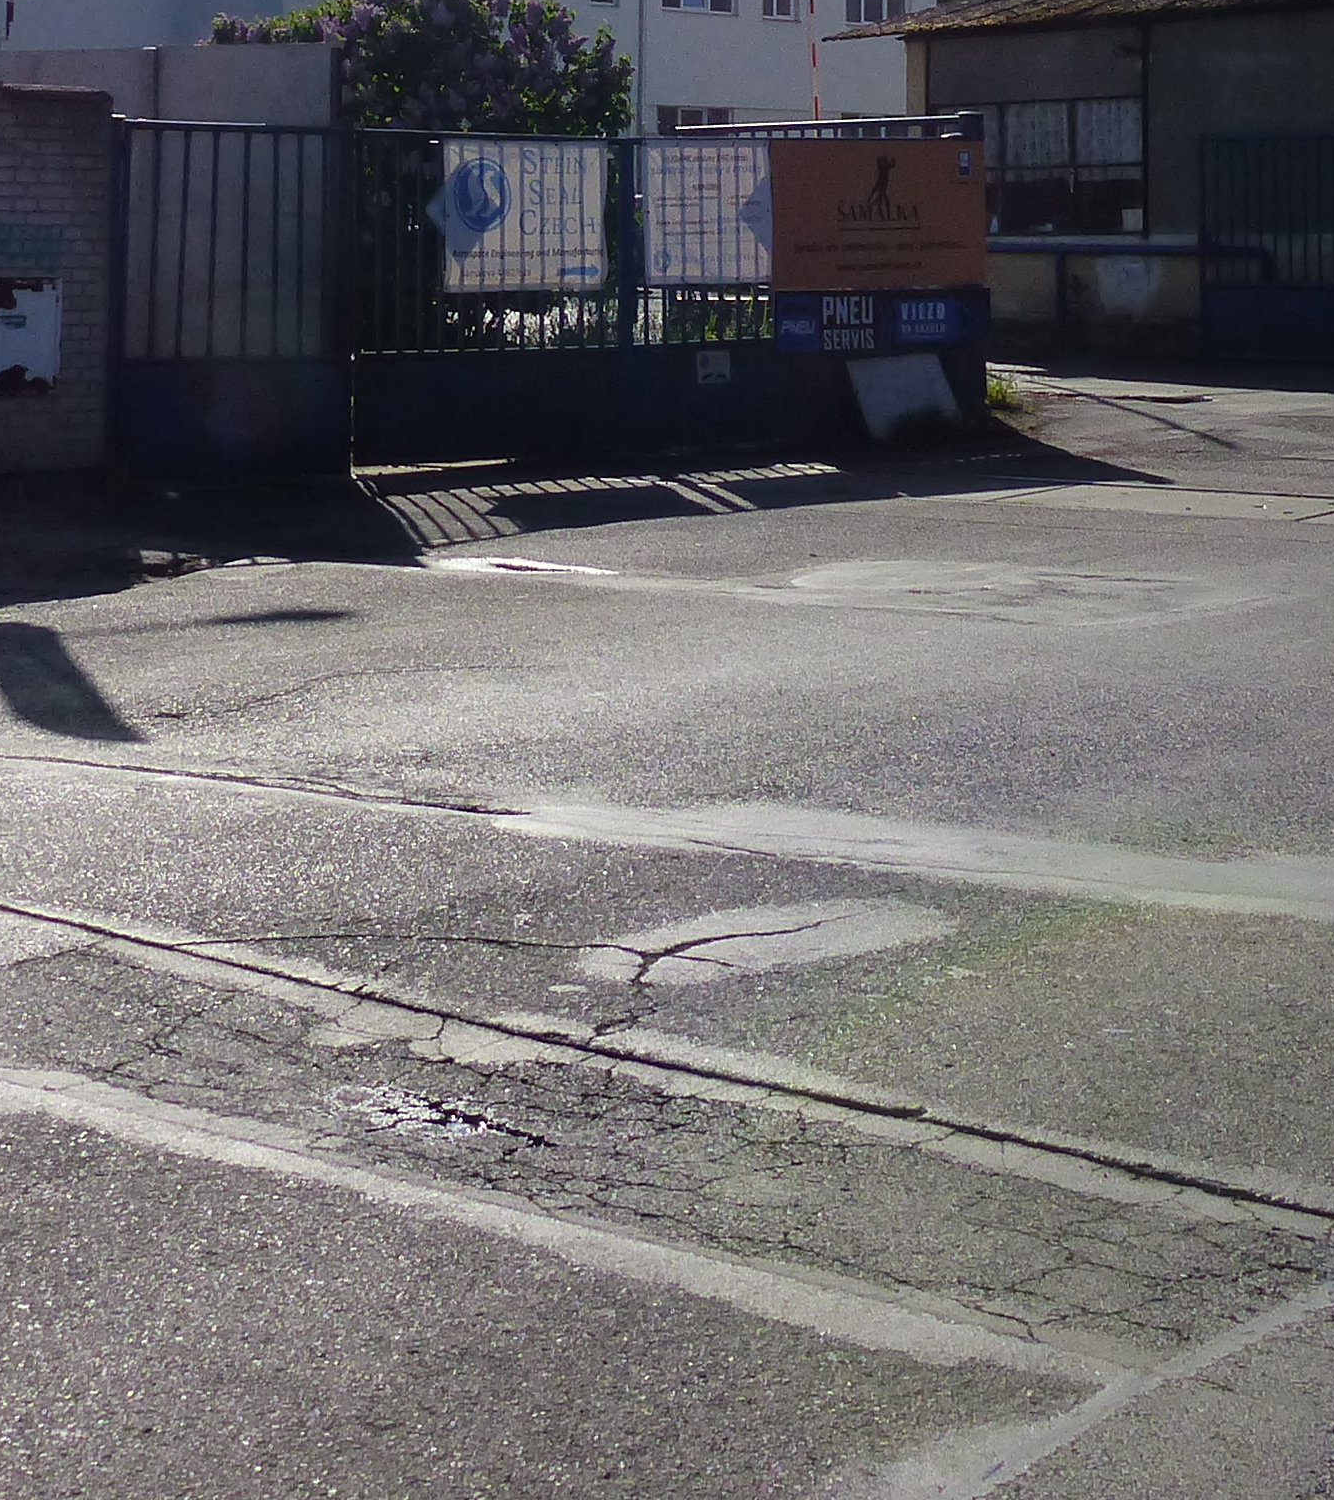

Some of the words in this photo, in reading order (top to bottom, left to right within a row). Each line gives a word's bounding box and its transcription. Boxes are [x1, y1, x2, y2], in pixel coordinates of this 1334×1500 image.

[822, 296, 874, 325] PNEU
[901, 302, 946, 321] VJEZD
[823, 329, 875, 351] SERVIS
